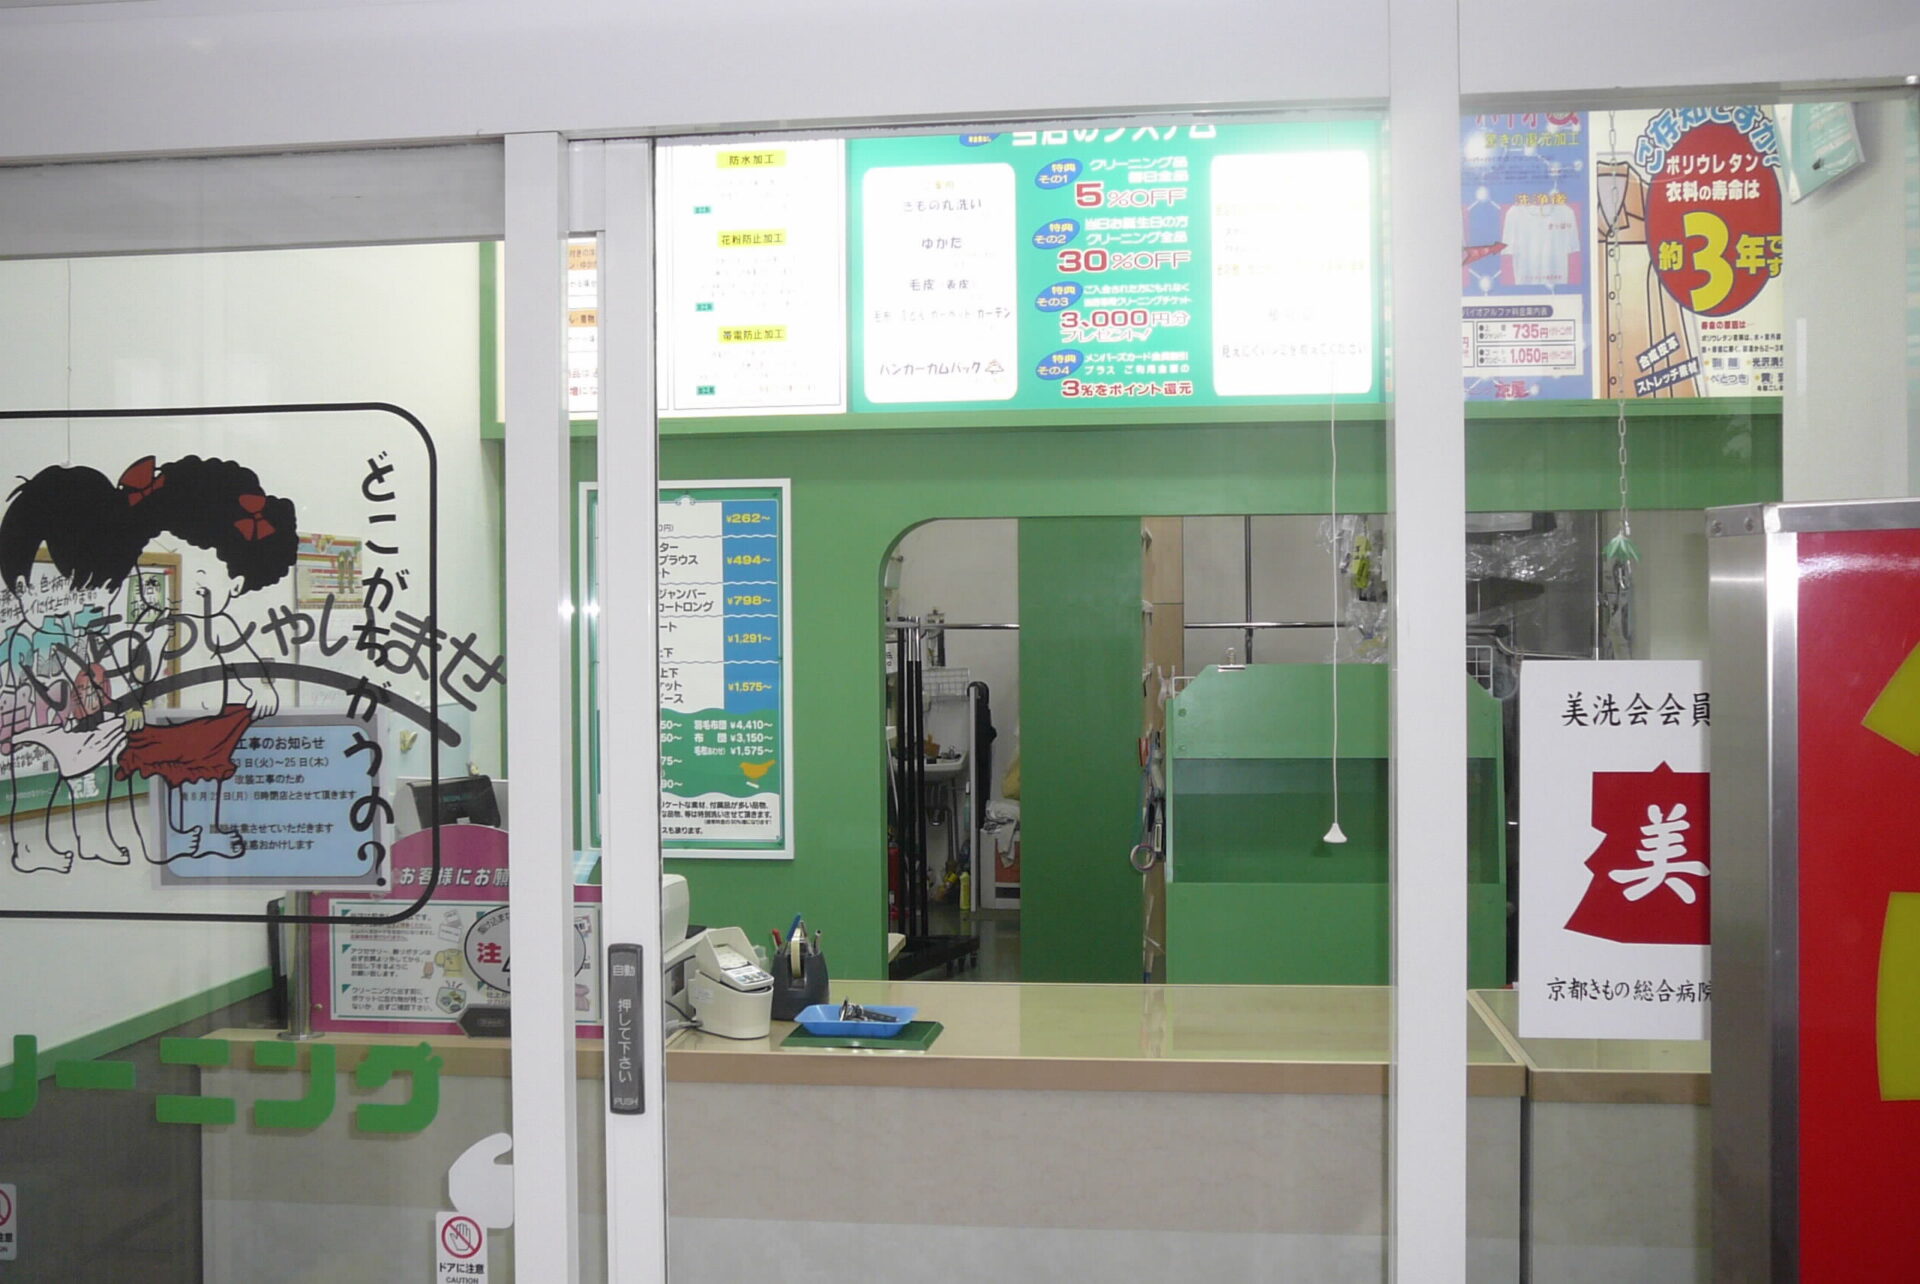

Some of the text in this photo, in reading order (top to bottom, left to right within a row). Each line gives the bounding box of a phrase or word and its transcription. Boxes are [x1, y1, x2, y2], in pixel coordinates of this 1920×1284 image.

[729, 154, 775, 165] 防水加工
[1666, 153, 1759, 175] ポリウレタン
[1075, 181, 1188, 208] 5%OFF
[1666, 179, 1760, 202] 衣料の寿命は
[1058, 249, 1191, 273] 30%OFF
[1562, 691, 1711, 727] 美洗会会員
[1608, 803, 1711, 904] 美
[613, 964, 635, 976] 自動
[618, 999, 632, 1082] 押して下さい
[440, 1262, 485, 1274] ドアに注意
